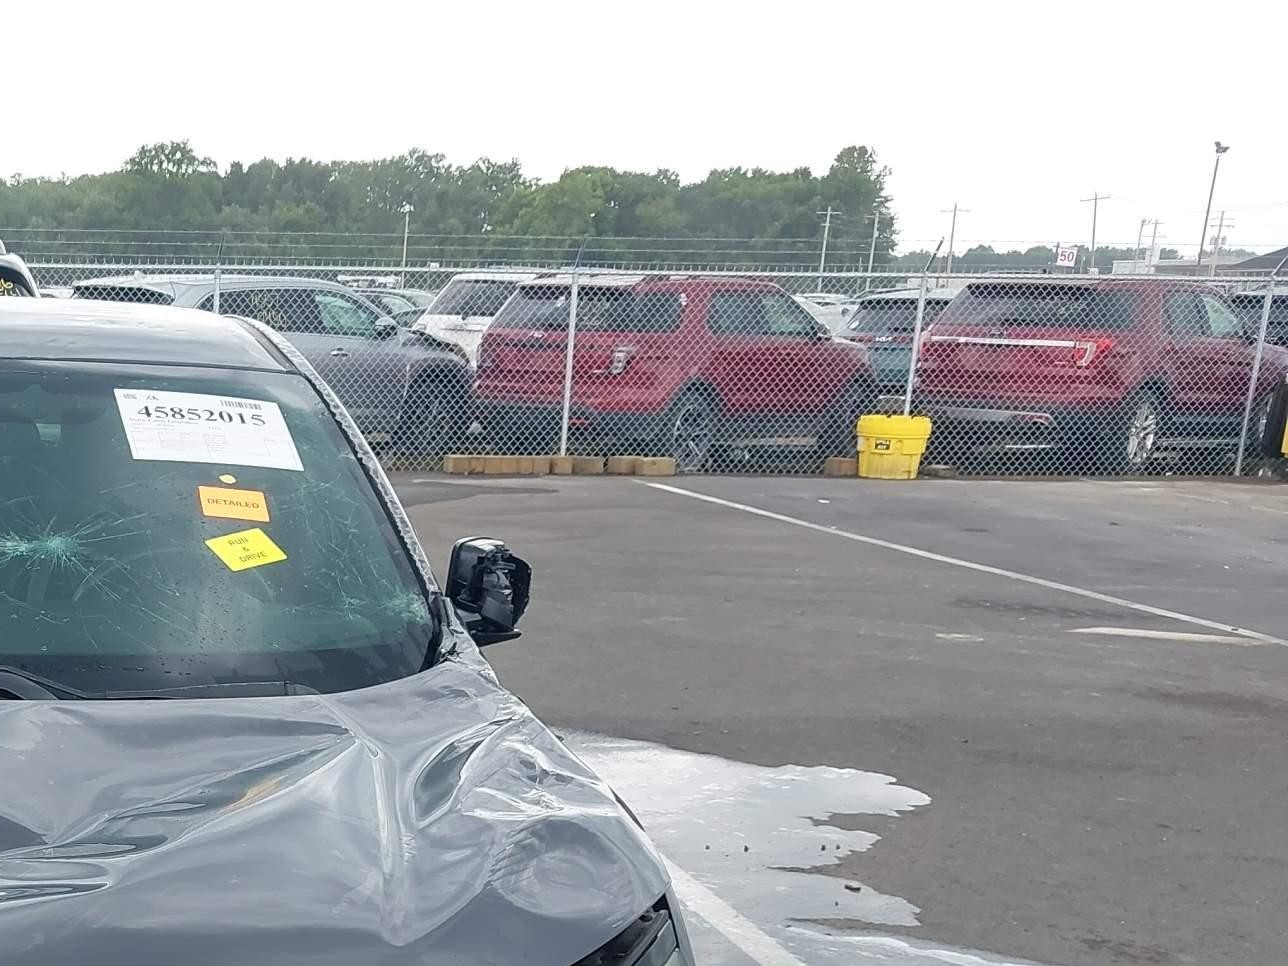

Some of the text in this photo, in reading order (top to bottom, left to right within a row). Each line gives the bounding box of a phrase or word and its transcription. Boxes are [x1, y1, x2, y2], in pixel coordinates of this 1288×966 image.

[1059, 250, 1074, 262] 50
[137, 405, 266, 427] 45852015
[207, 498, 260, 509] DETAILED
[227, 537, 249, 546] RUN
[239, 551, 268, 562] DRIVE
